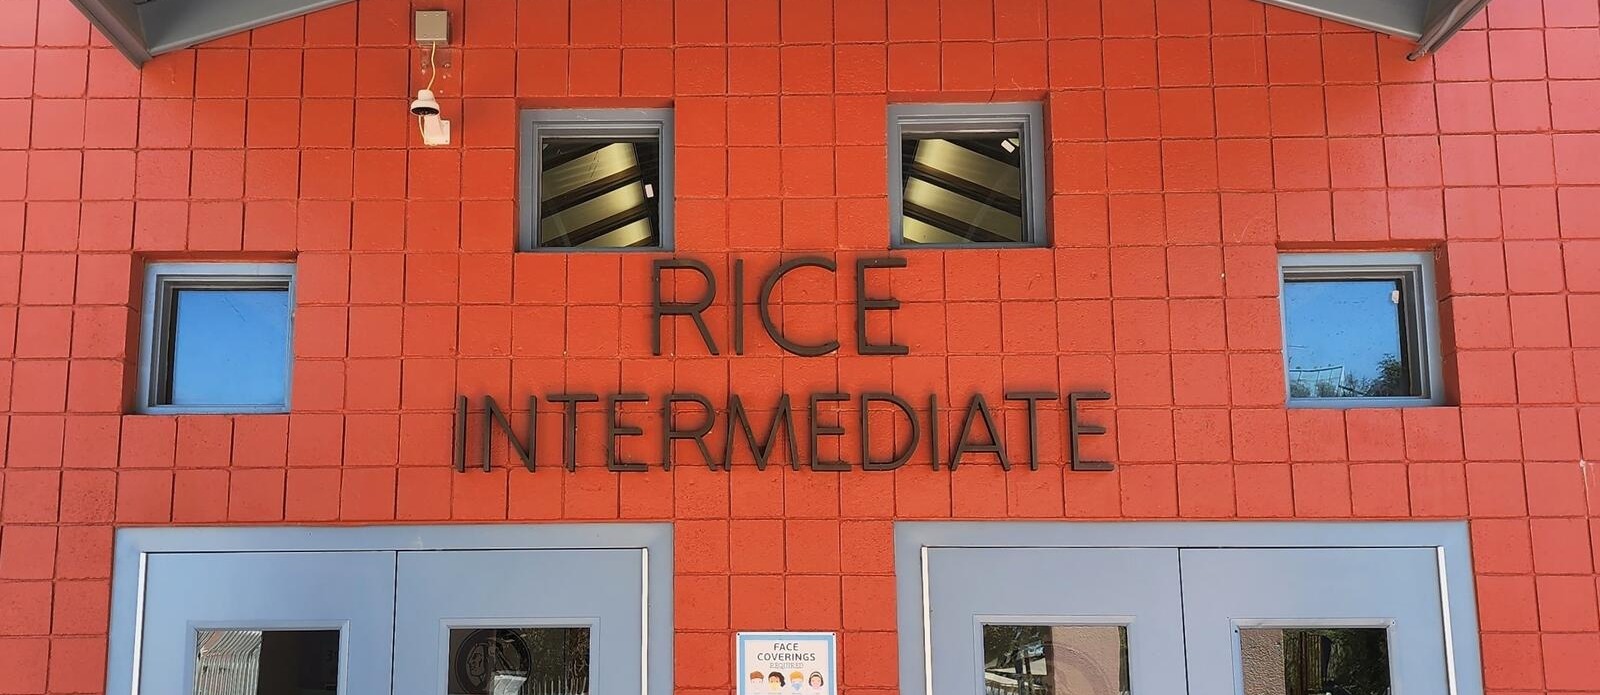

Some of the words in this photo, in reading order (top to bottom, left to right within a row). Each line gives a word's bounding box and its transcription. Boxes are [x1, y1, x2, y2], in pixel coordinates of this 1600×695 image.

[651, 257, 909, 357] RICE
[455, 391, 1114, 473] INTERMEDIATE
[757, 653, 816, 661] COVERINGS
[773, 643, 799, 651] FACE
